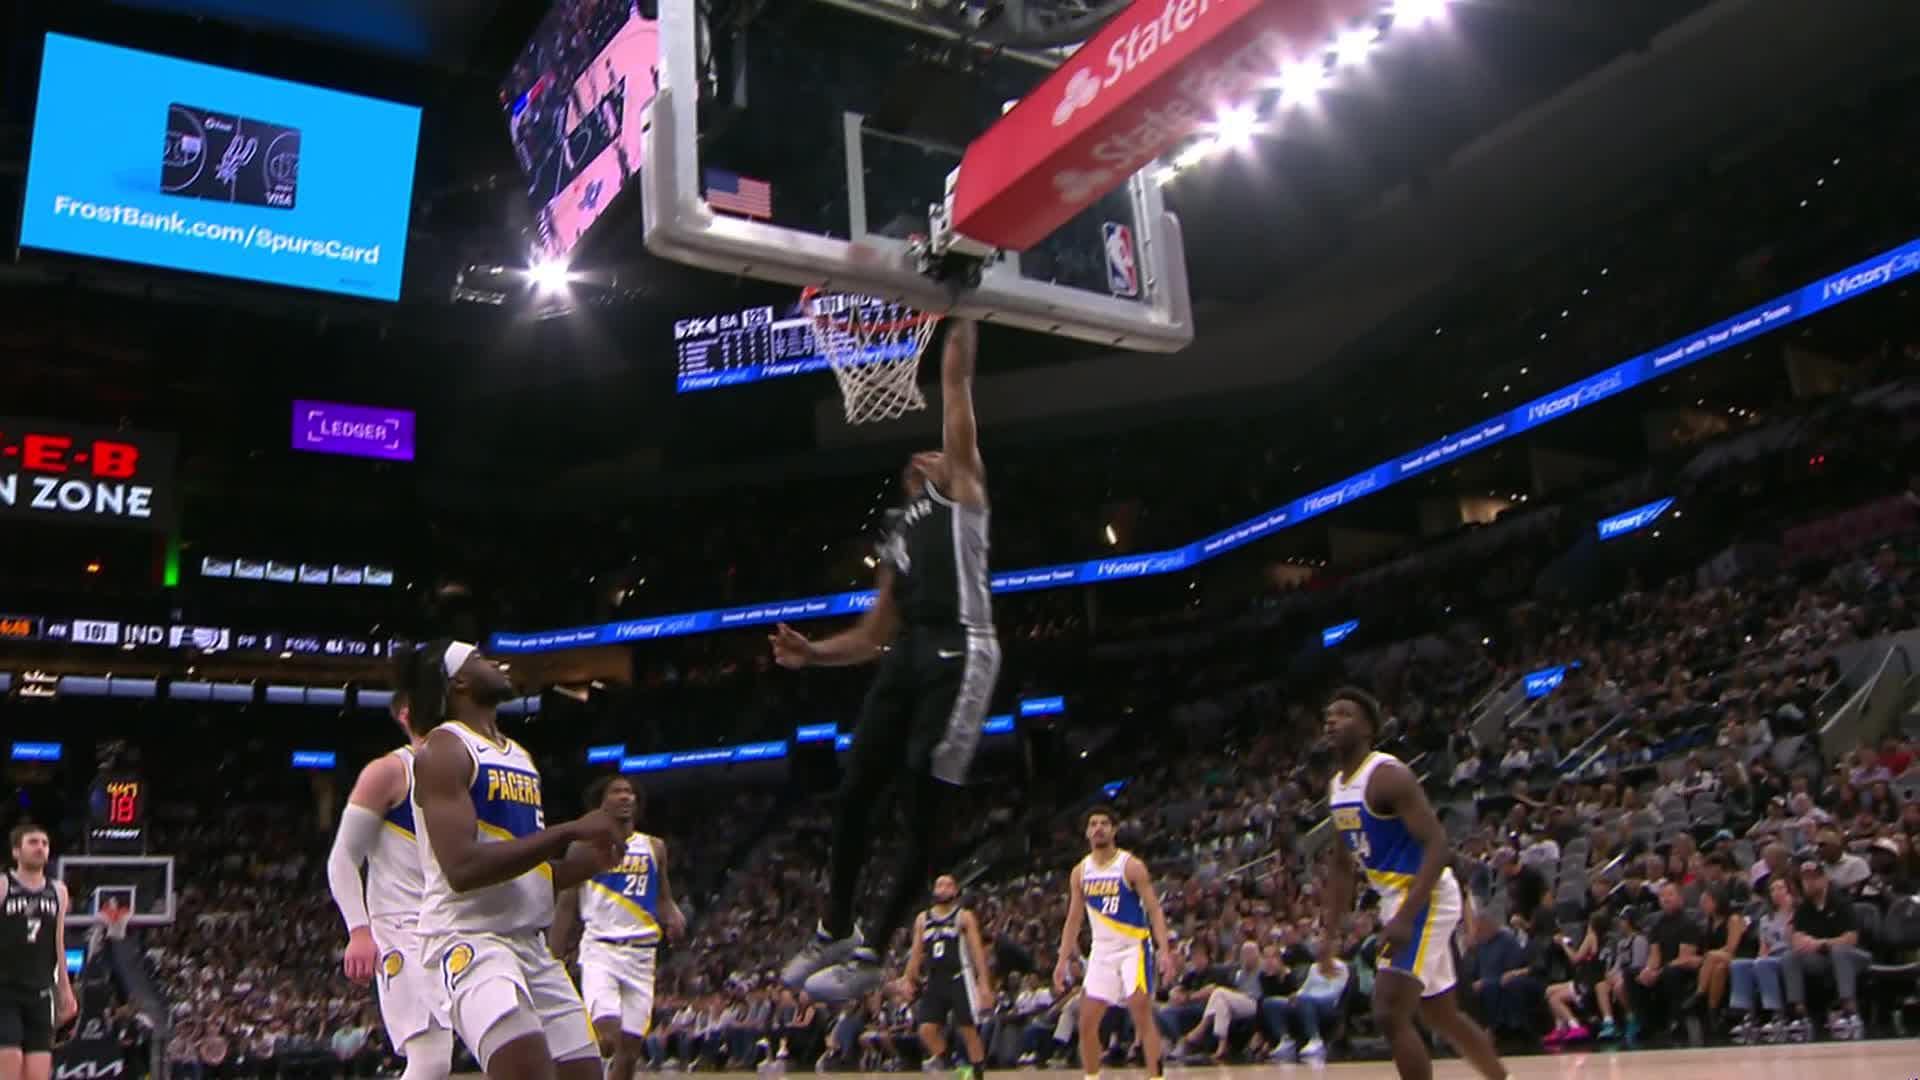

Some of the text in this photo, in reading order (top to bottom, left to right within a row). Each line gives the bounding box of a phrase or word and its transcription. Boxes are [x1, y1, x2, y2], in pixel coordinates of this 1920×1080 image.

[53, 195, 381, 266] FrostBank.com/SpursCard
[320, 418, 388, 441] LEDGER
[31, 476, 153, 518] ZONE
[125, 624, 164, 644] IND
[487, 768, 542, 806] PACERS
[111, 794, 135, 822] 18
[623, 874, 649, 897] 29
[27, 918, 42, 943] 7
[933, 940, 945, 959] 0
